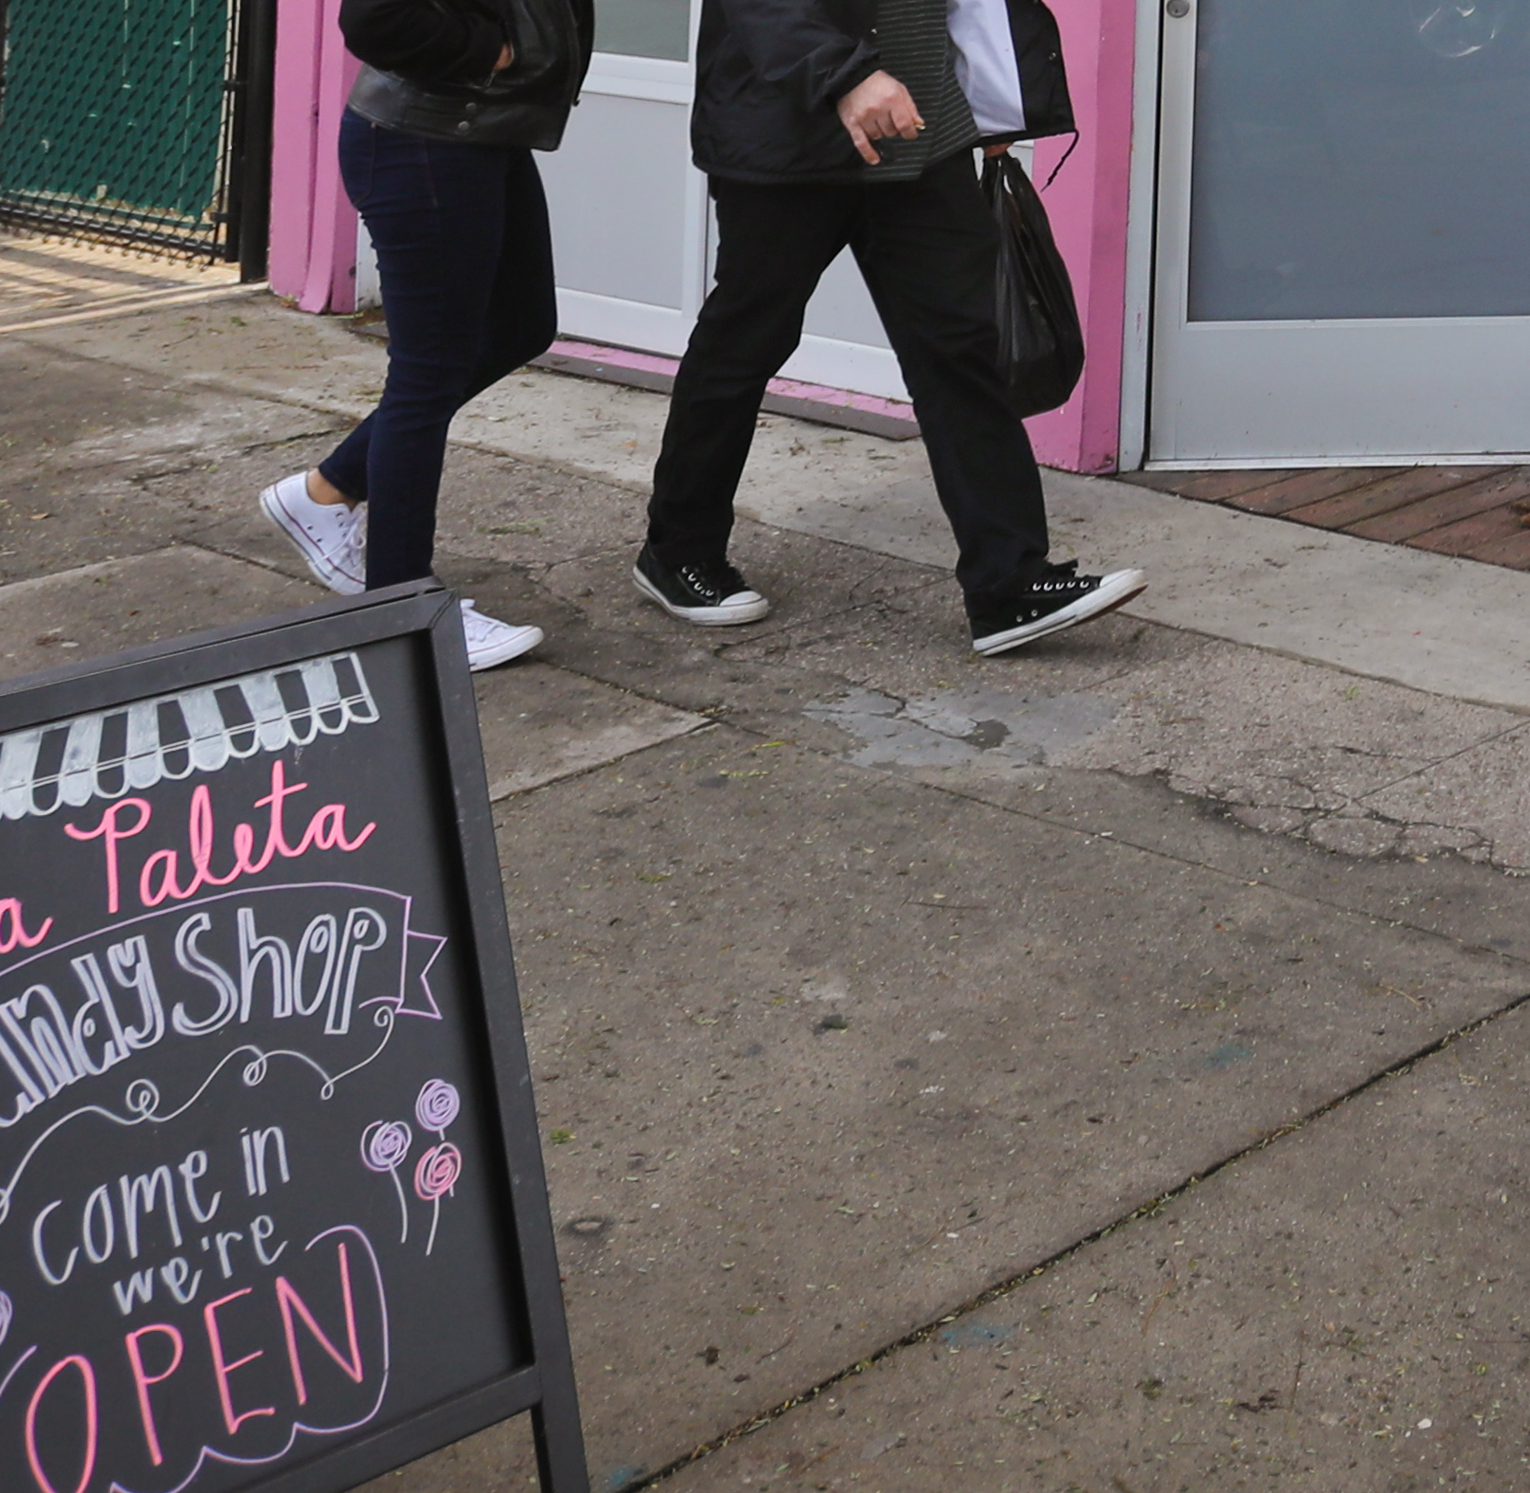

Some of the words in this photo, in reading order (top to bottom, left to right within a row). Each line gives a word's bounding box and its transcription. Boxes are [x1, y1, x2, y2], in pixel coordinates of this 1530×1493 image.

[63, 759, 377, 913] Paleta
[240, 1123, 291, 1197] in
[113, 1214, 290, 1315] we're
[24, 1241, 363, 1493] OPEN
